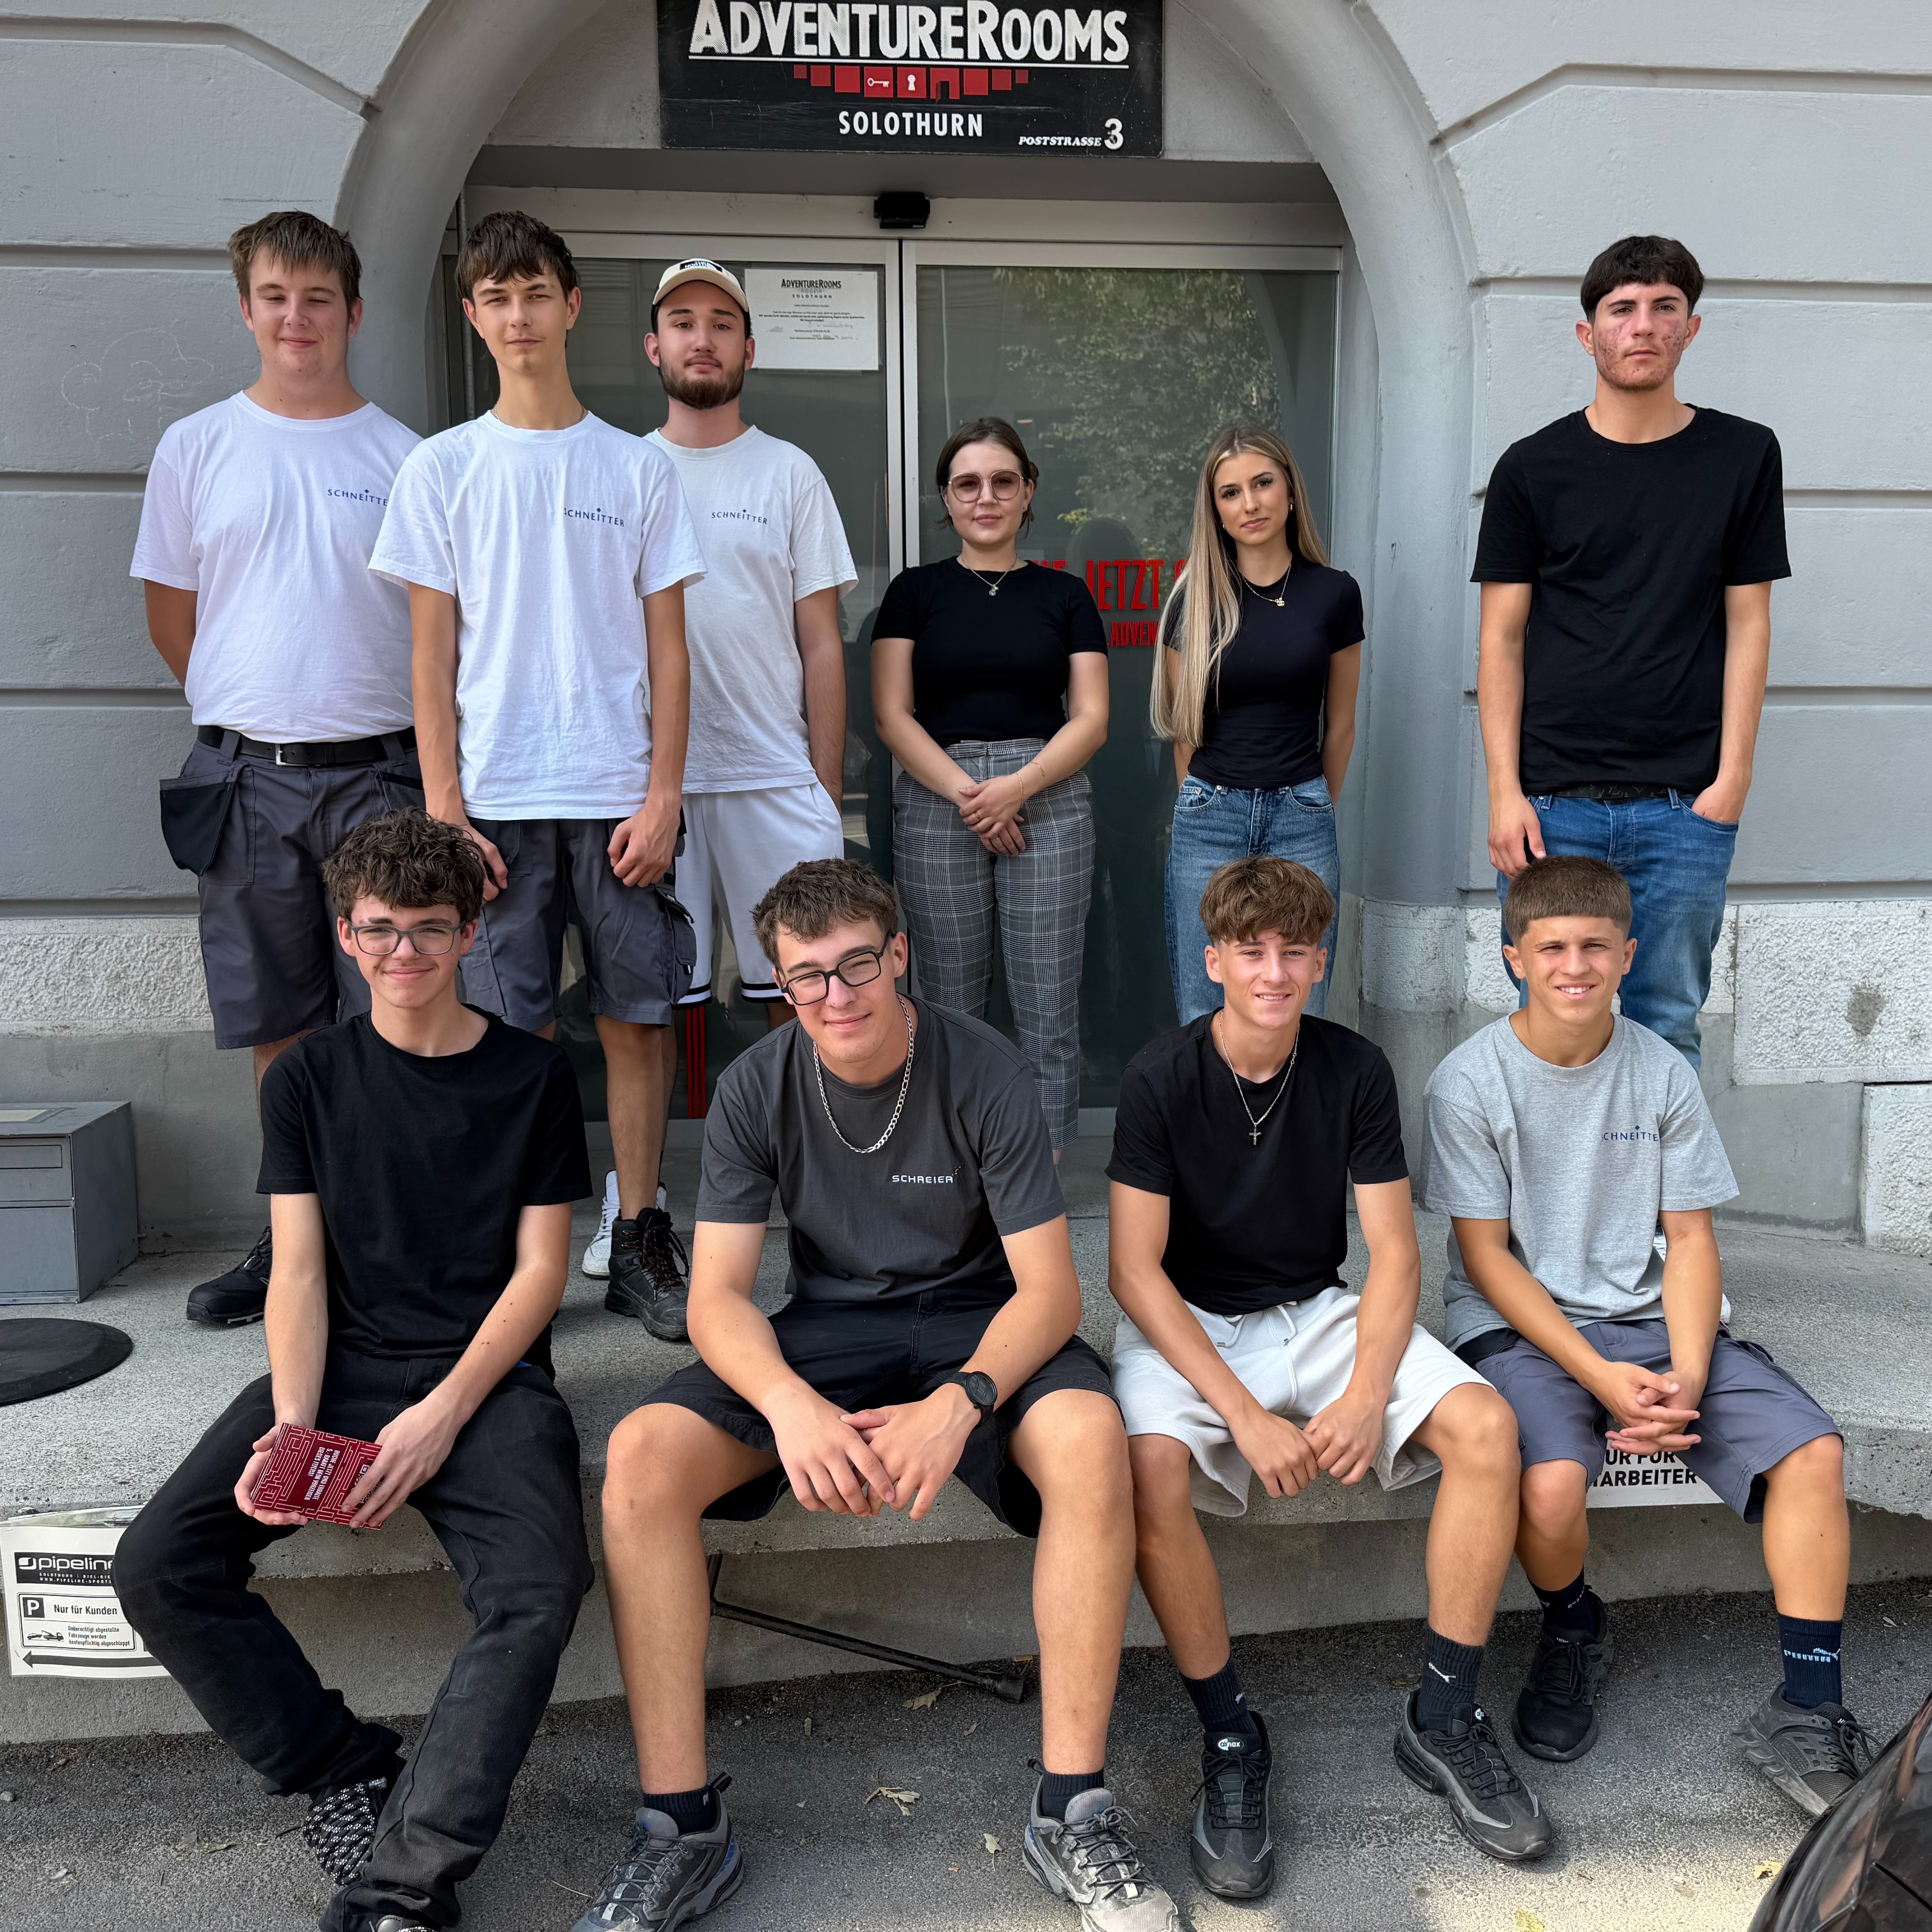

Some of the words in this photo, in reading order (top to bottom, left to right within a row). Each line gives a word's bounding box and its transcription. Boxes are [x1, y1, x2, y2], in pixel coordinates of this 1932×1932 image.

[839, 111, 983, 137] SOLOTHURN
[1018, 136, 1102, 147] POSTSTRASSE
[1104, 118, 1124, 150] 3
[711, 509, 767, 525] SCHNEITTER
[892, 1175, 953, 1184] SCHREIER
[27, 1599, 39, 1616] P
[54, 1604, 68, 1613] Nur
[71, 1605, 83, 1614] für
[85, 1606, 117, 1615] Kunden
